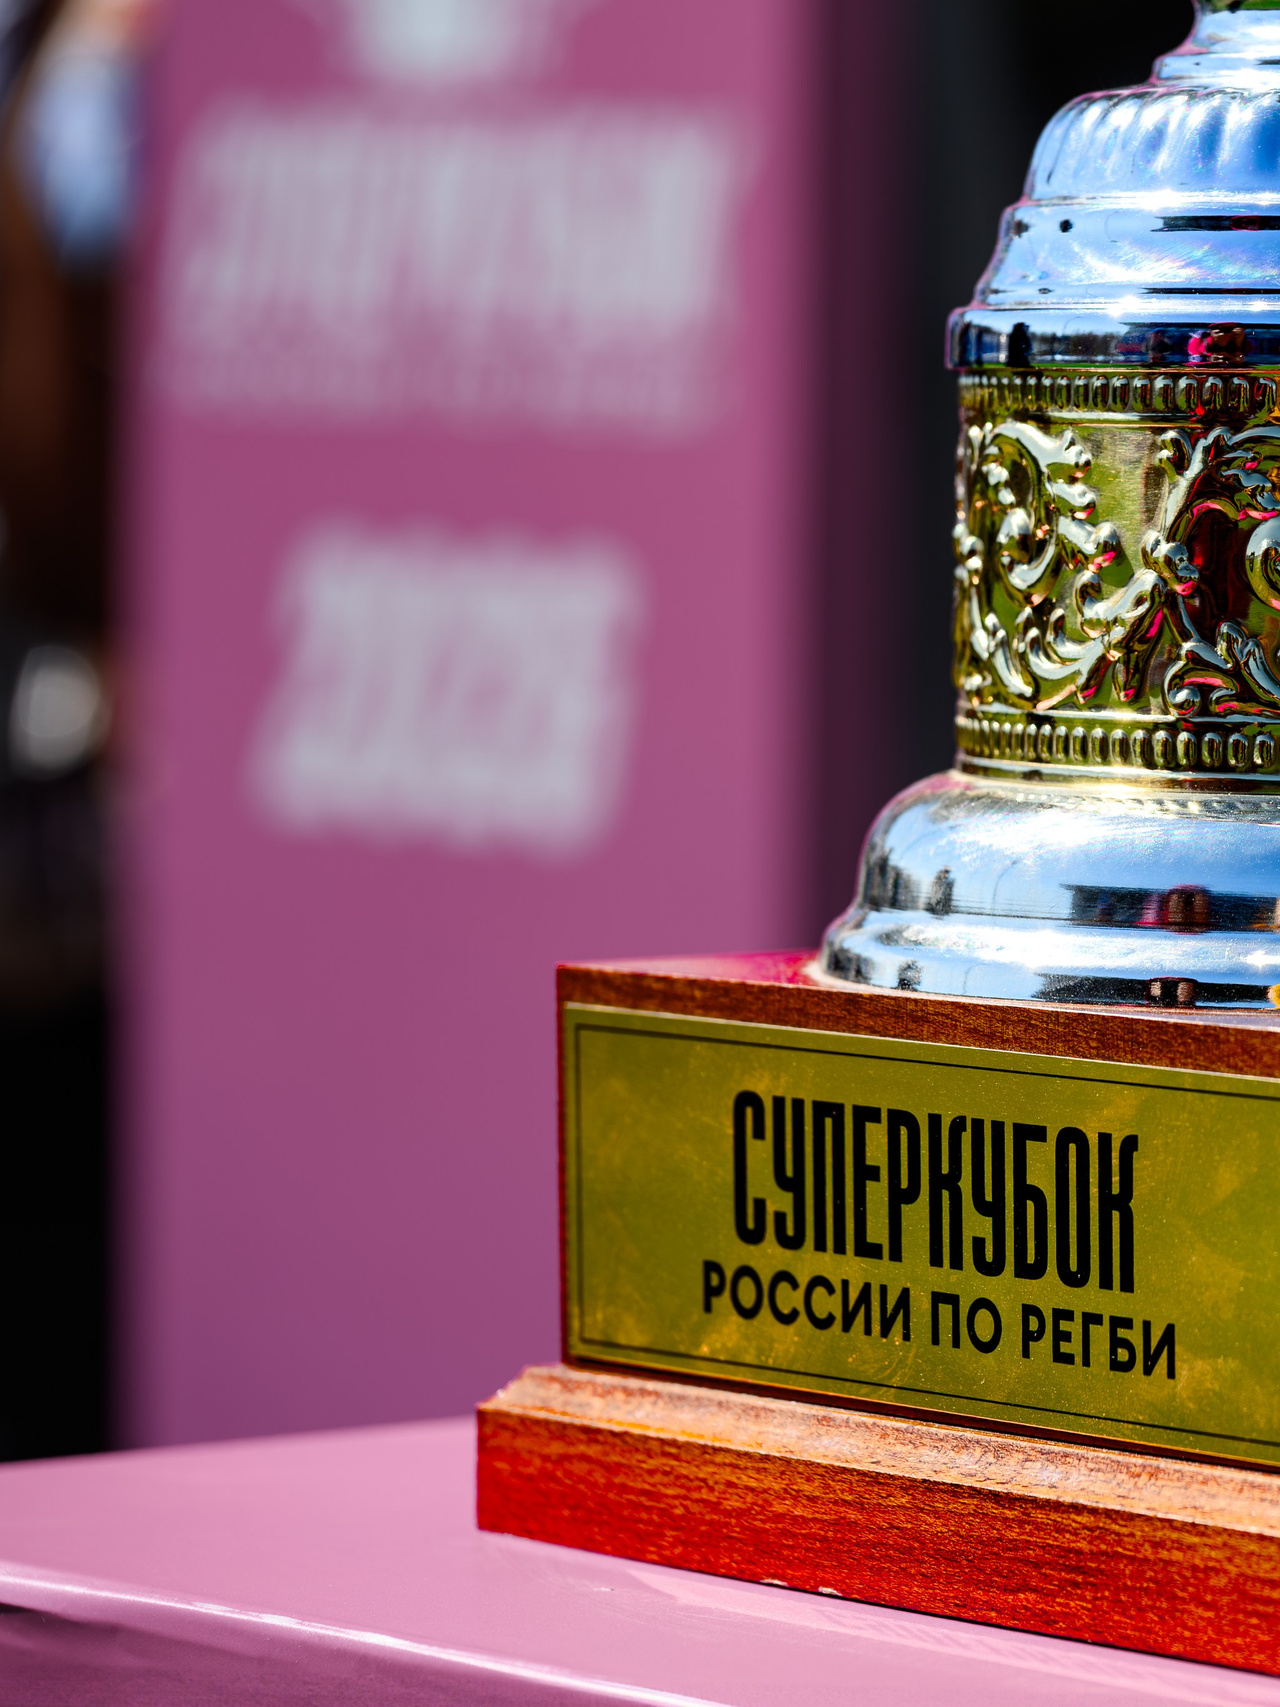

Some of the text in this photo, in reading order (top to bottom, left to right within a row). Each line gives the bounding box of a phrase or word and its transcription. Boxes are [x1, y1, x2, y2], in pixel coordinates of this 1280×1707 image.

[733, 1089, 1139, 1294] СУПЕРКУБОК
[702, 1259, 1177, 1381] РОССИИ ПО РЕГБИ
